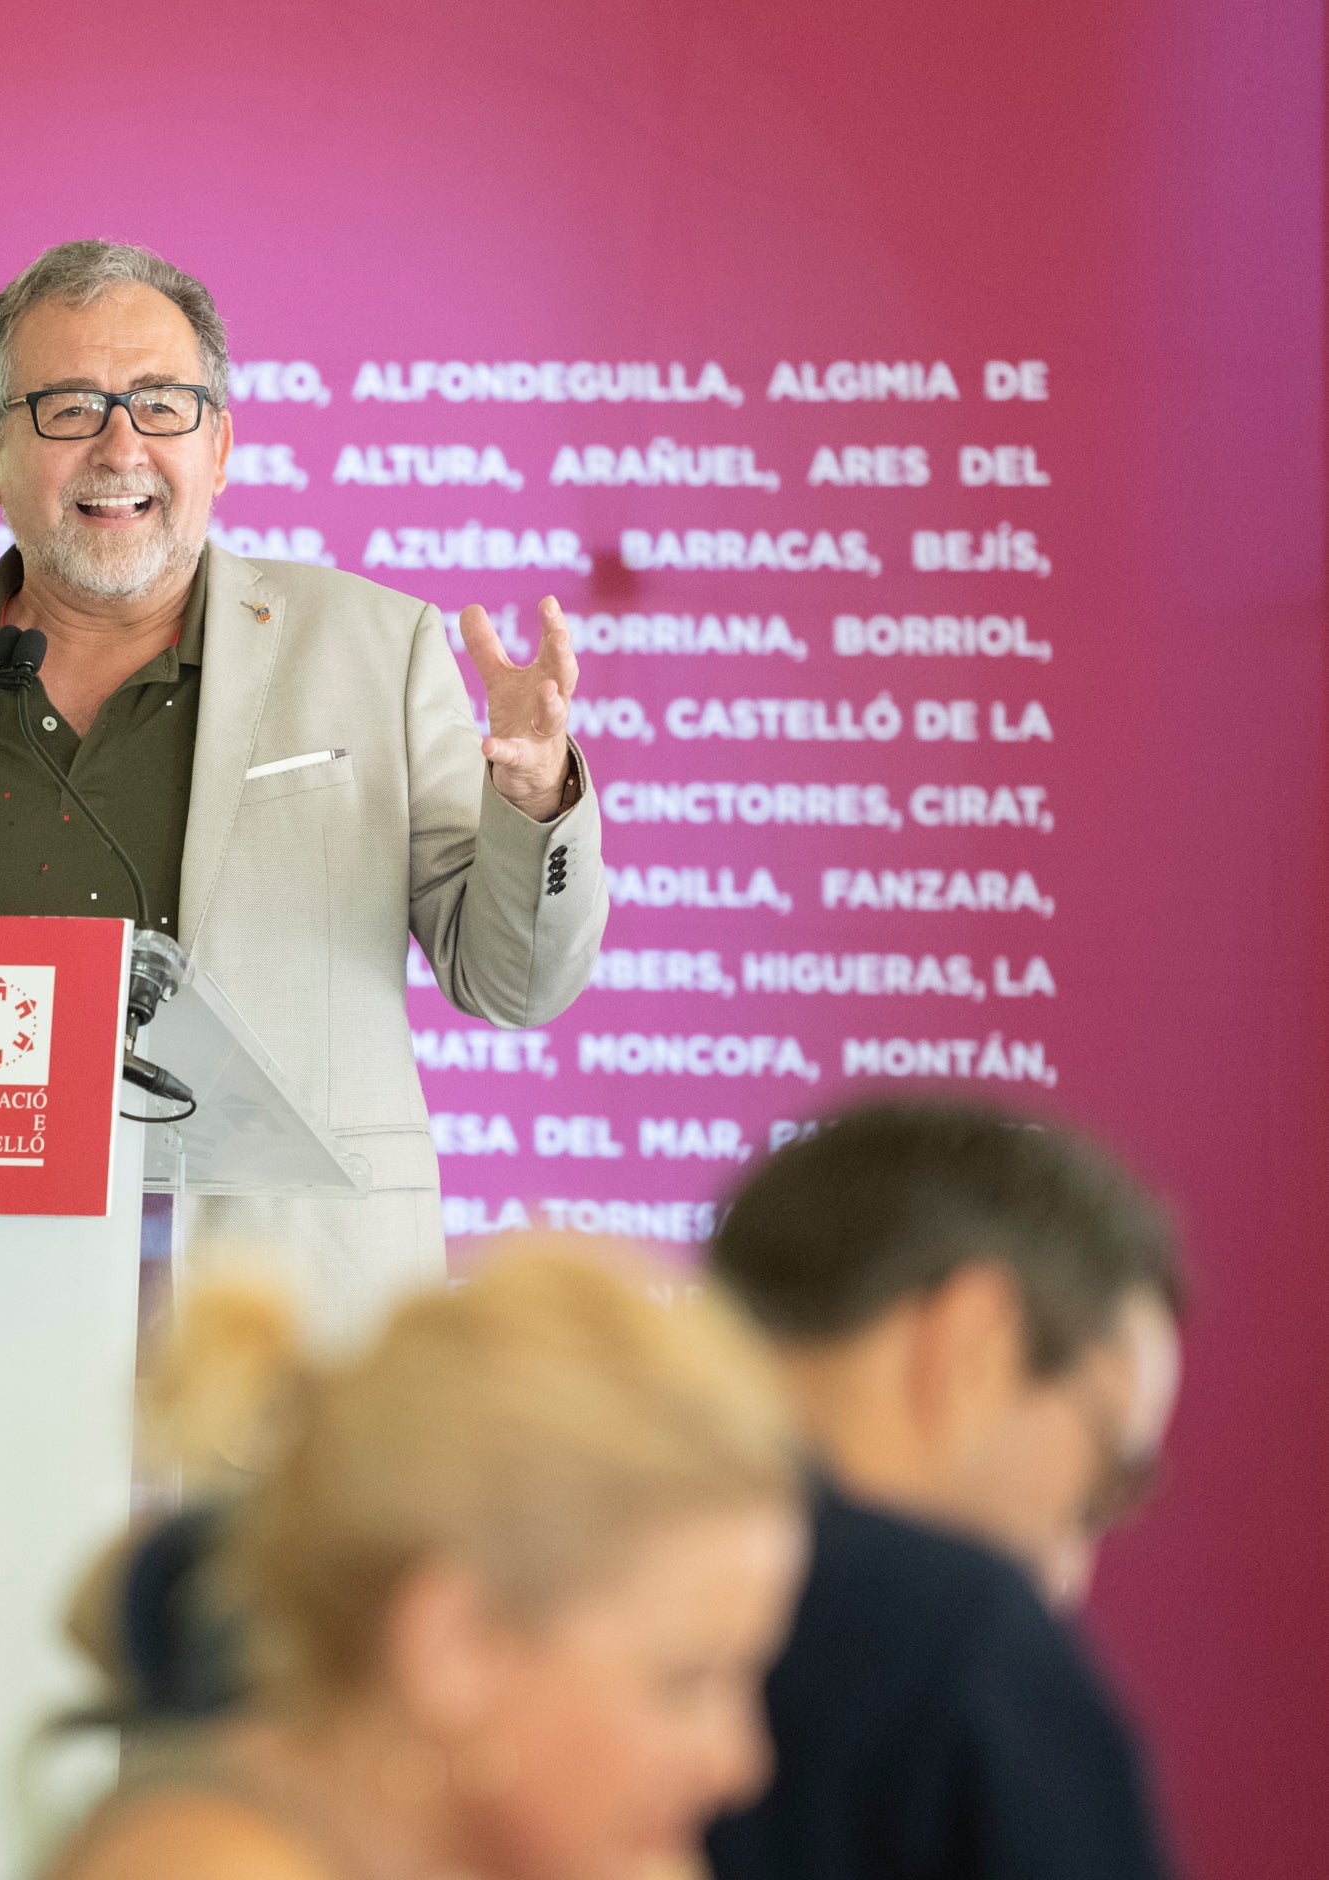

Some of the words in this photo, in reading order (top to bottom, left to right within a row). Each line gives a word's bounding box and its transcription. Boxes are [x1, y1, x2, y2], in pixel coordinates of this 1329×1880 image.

[353, 360, 744, 407] ALFONDEGUILLA,
[768, 361, 959, 402] ALGIMIA
[985, 361, 1048, 401] DE
[334, 444, 524, 491] ALTURA,
[550, 438, 781, 492] ARAÑUEL,
[808, 446, 930, 486] ARES
[959, 446, 1050, 486] DEL
[363, 521, 592, 575] AZUÉBAR,
[620, 528, 882, 578] BARRACAS,
[912, 522, 1052, 578] BEJÍS,
[833, 614, 1053, 662] BORRIOL,
[665, 692, 903, 741] CASTELLÓ
[913, 700, 978, 741] DE
[989, 700, 1053, 743] LA
[602, 781, 904, 833] CINCTORRES,
[910, 785, 1054, 833] CIRAT,
[822, 869, 1055, 920] FANZARA,
[742, 953, 986, 1003] HIGUERAS,
[993, 956, 1057, 1000] LA
[577, 1032, 820, 1083] MONCOFA,
[843, 1030, 1058, 1087] MONTÁN,
[33, 1114, 47, 1132] E
[532, 1114, 625, 1159] DEL
[637, 1118, 753, 1164] MAR,
[540, 1198, 716, 1242] TORNES
